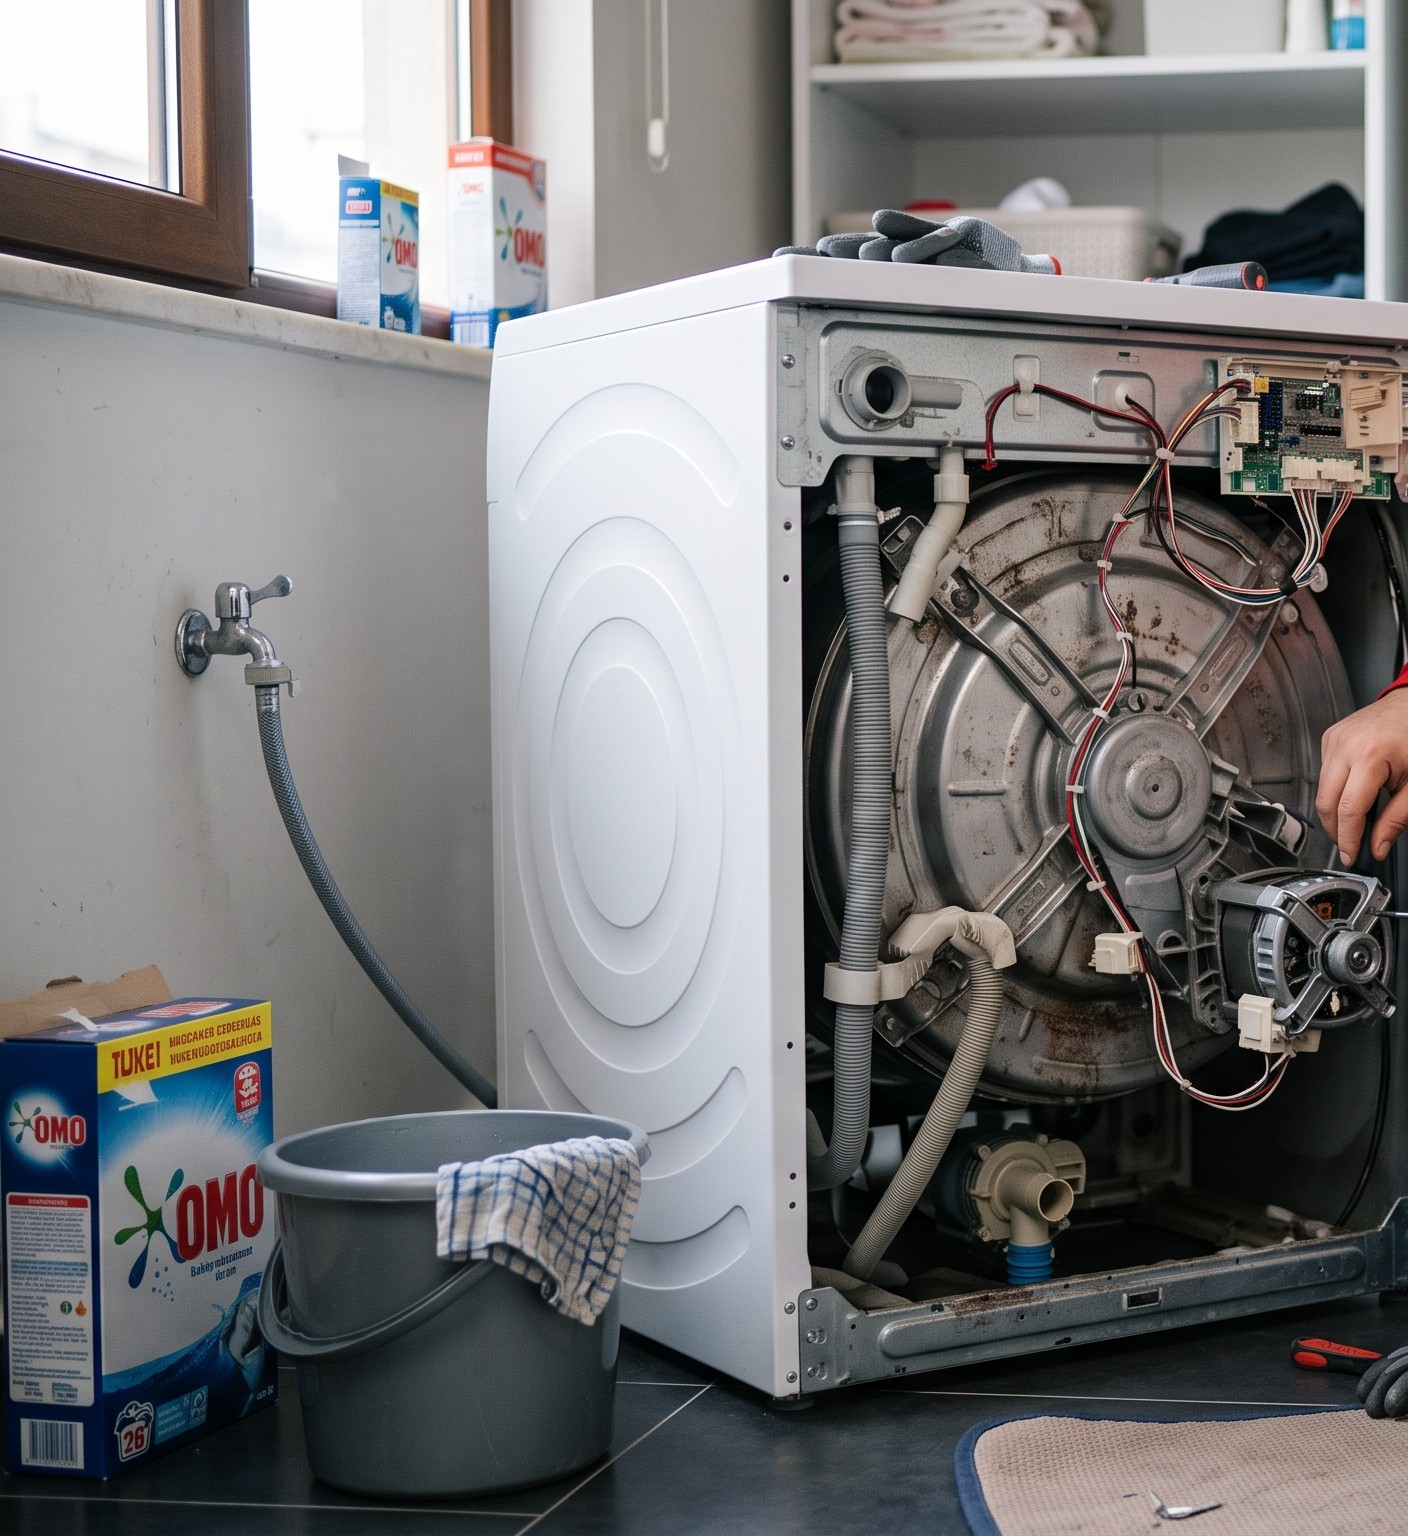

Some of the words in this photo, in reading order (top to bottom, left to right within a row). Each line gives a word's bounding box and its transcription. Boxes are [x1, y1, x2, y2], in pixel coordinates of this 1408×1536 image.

[34, 1115, 86, 1145] OMO
[176, 1164, 264, 1261] OMO
[123, 1426, 145, 1455] 26
